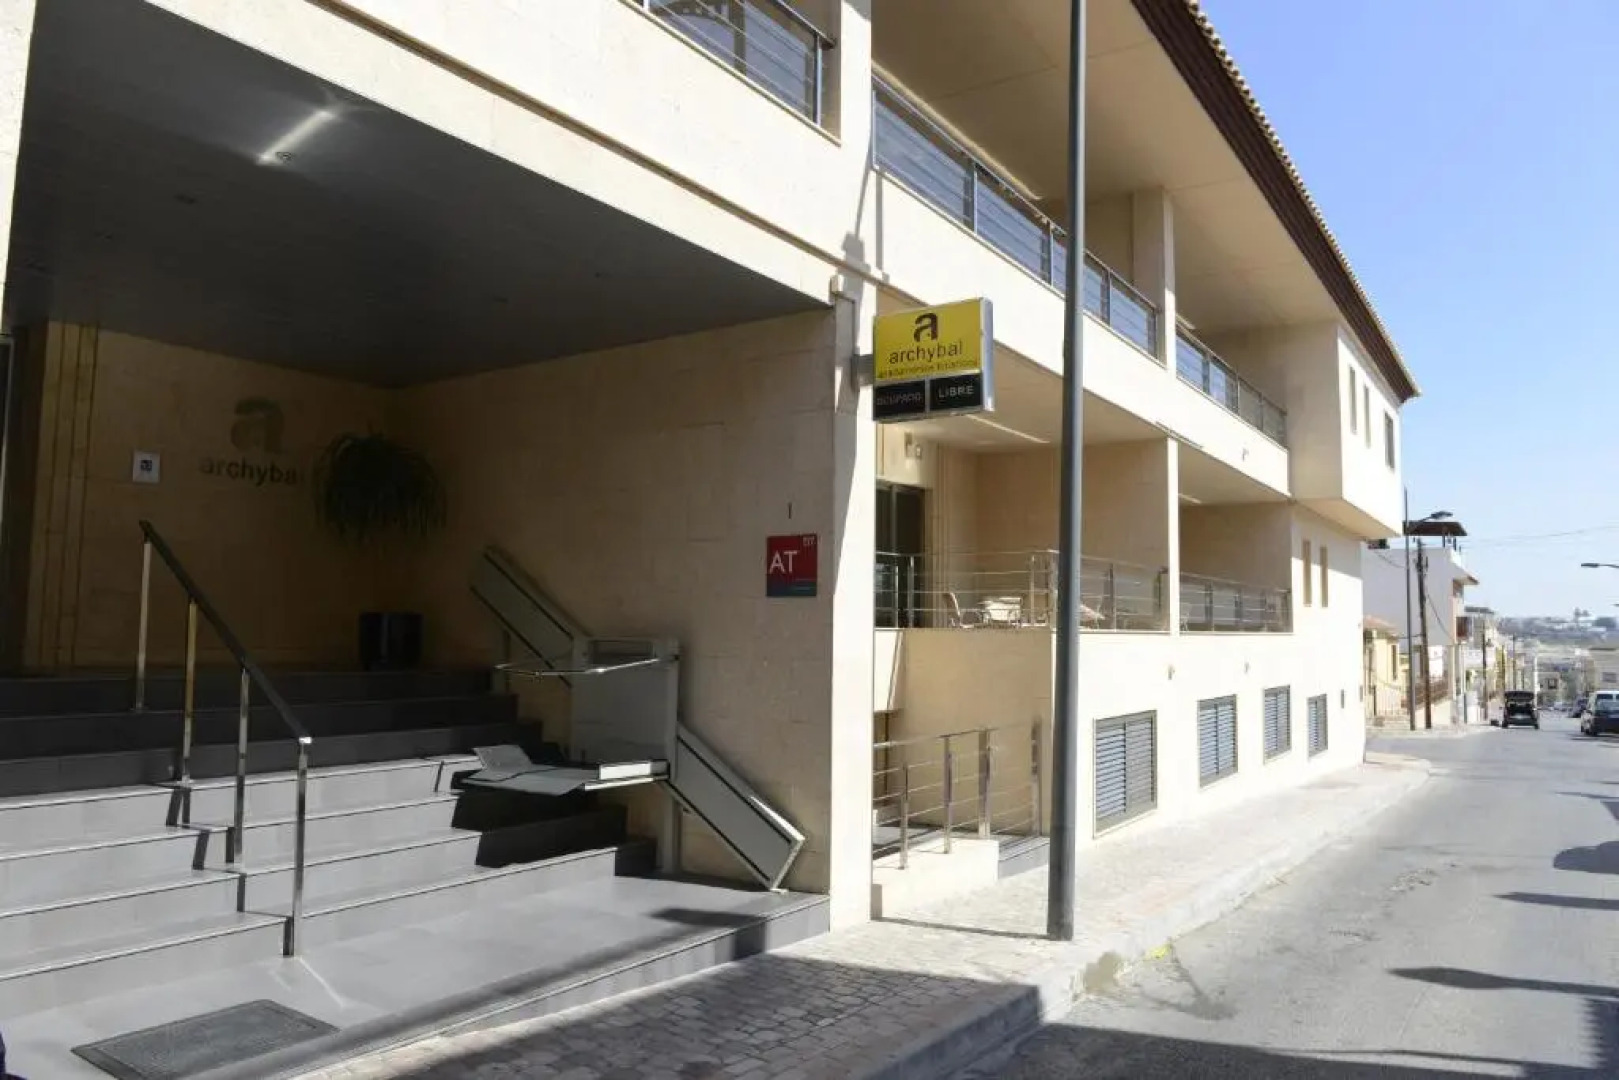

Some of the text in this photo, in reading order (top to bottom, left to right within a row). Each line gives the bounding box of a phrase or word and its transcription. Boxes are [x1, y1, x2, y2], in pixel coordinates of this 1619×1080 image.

[889, 341, 963, 365] archybal
[938, 385, 975, 398] LIBRE
[769, 549, 798, 574] AT
